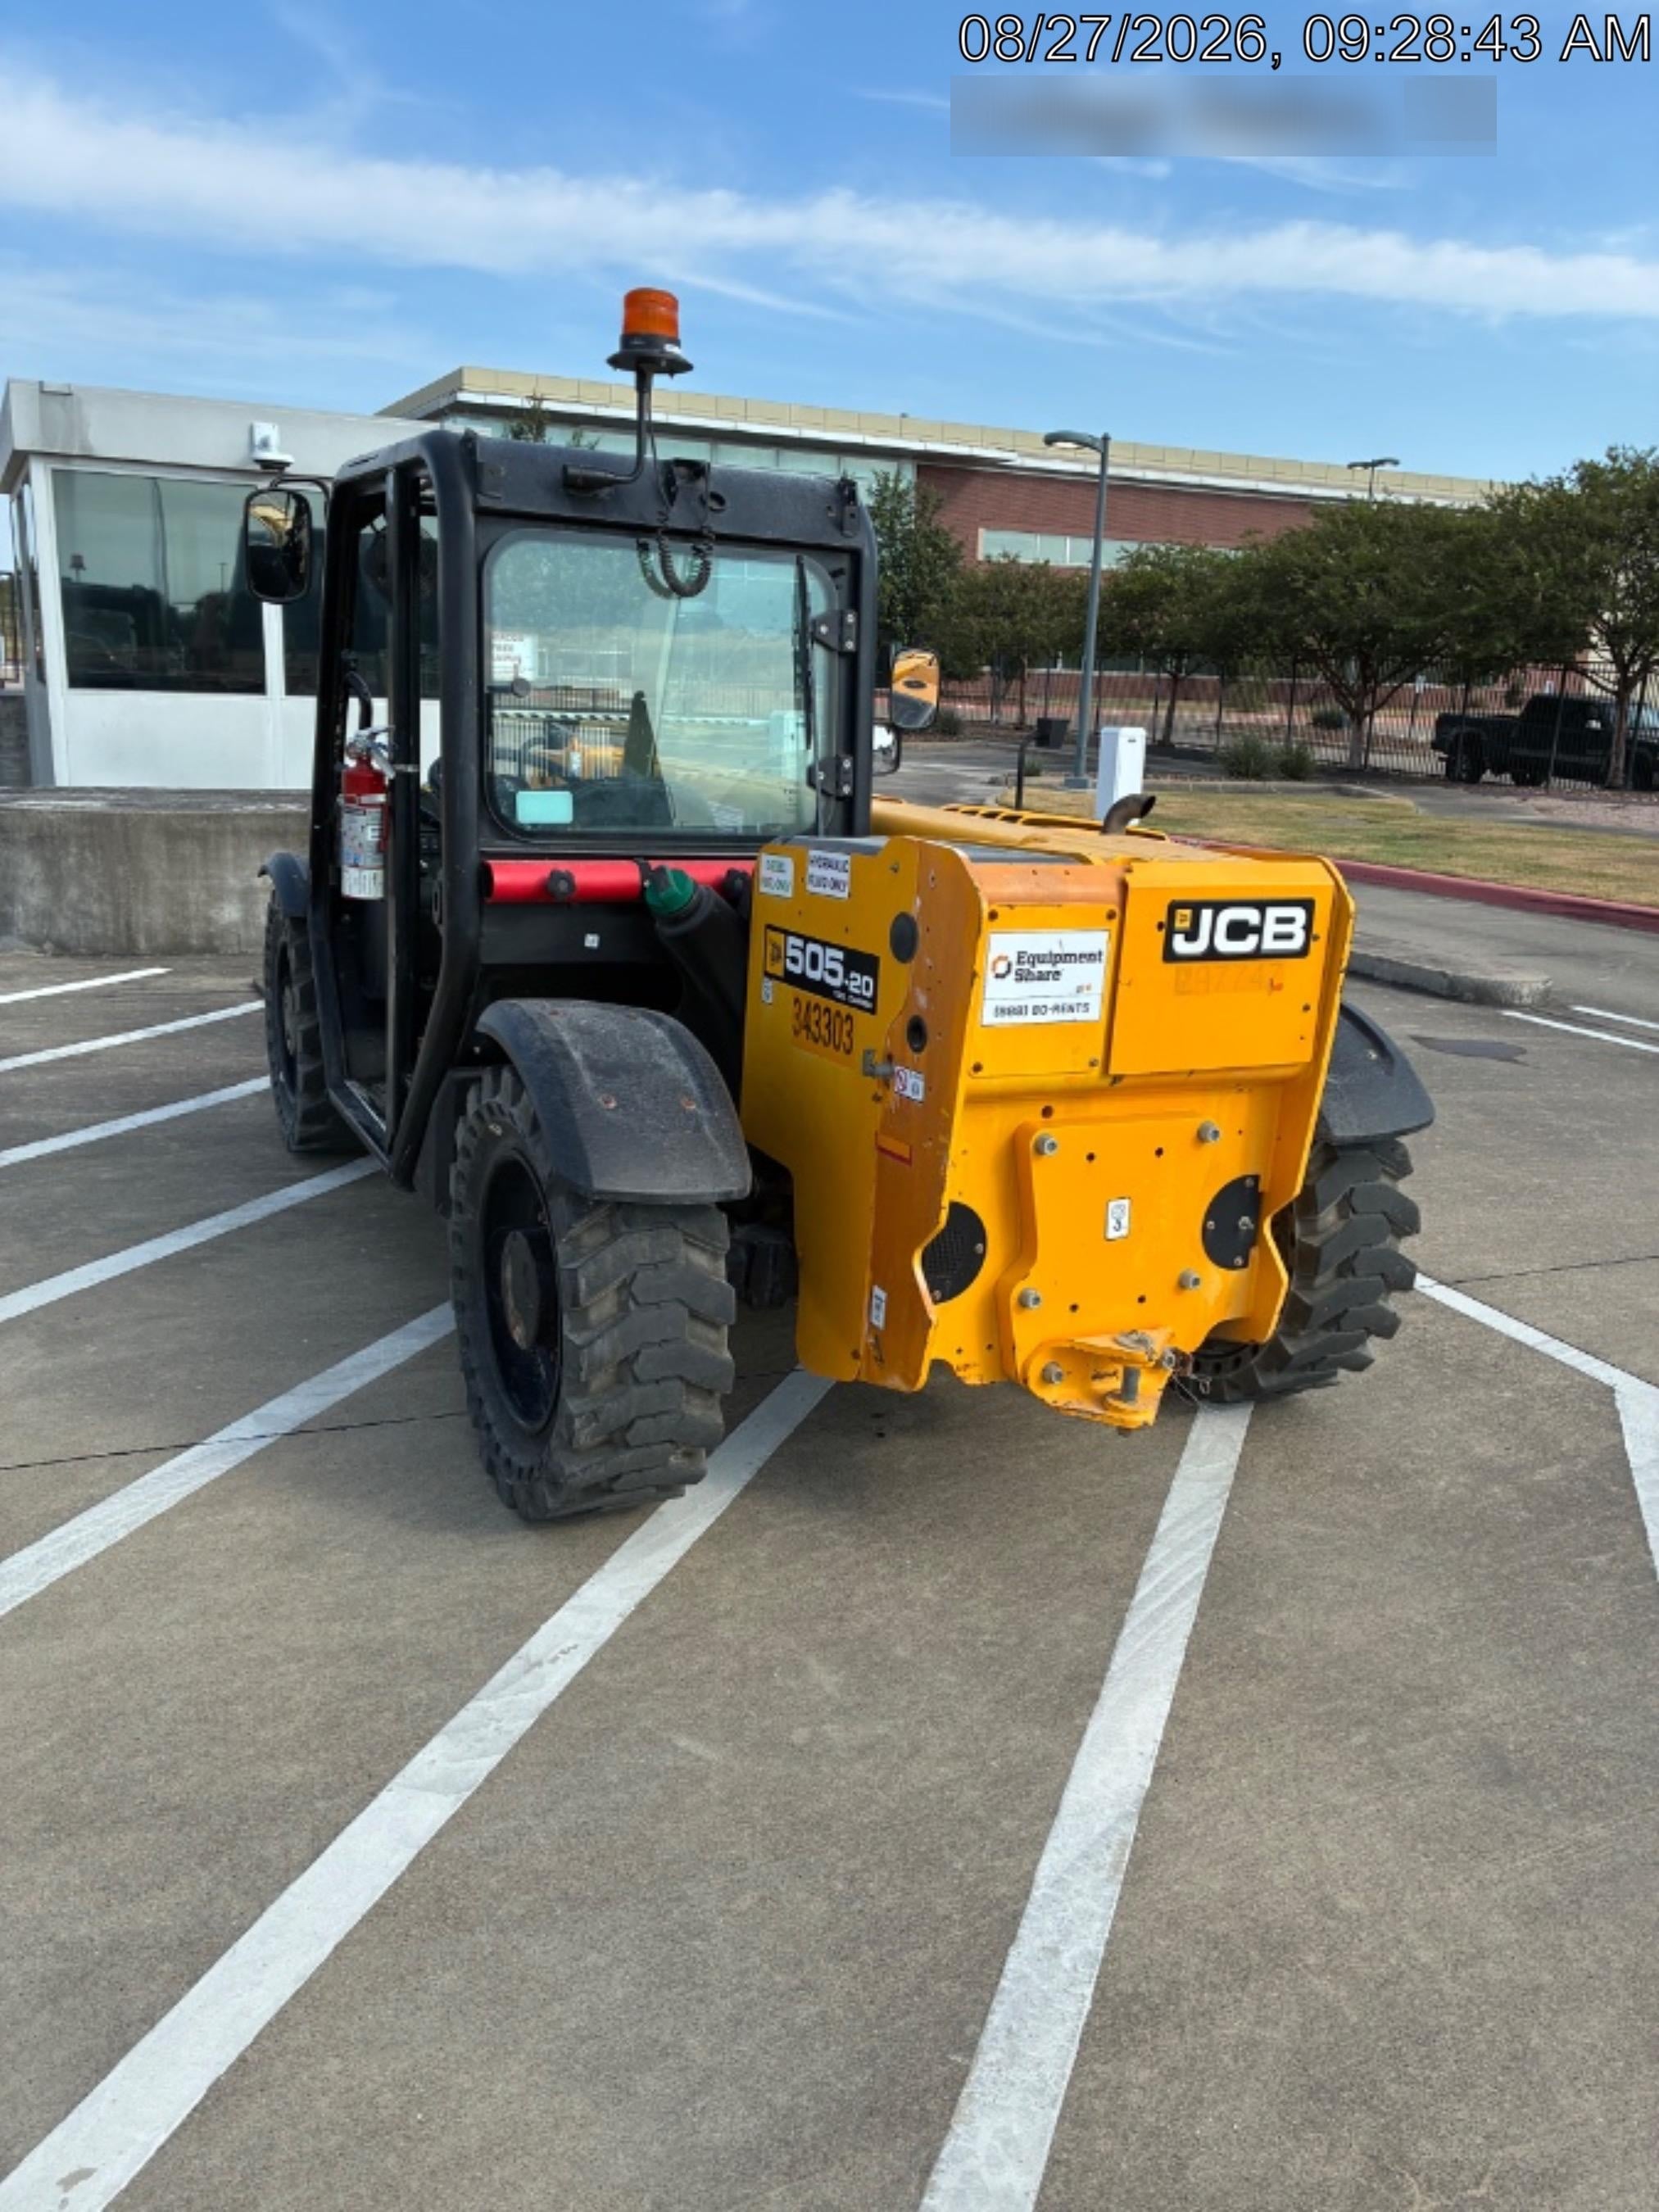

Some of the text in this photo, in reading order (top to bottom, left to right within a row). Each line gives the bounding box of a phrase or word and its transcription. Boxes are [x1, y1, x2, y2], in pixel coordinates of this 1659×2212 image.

[1172, 905, 1308, 956] JCB
[1013, 968, 1063, 983] Share
[1015, 950, 1104, 968] Equipment
[791, 996, 854, 1056] 343303
